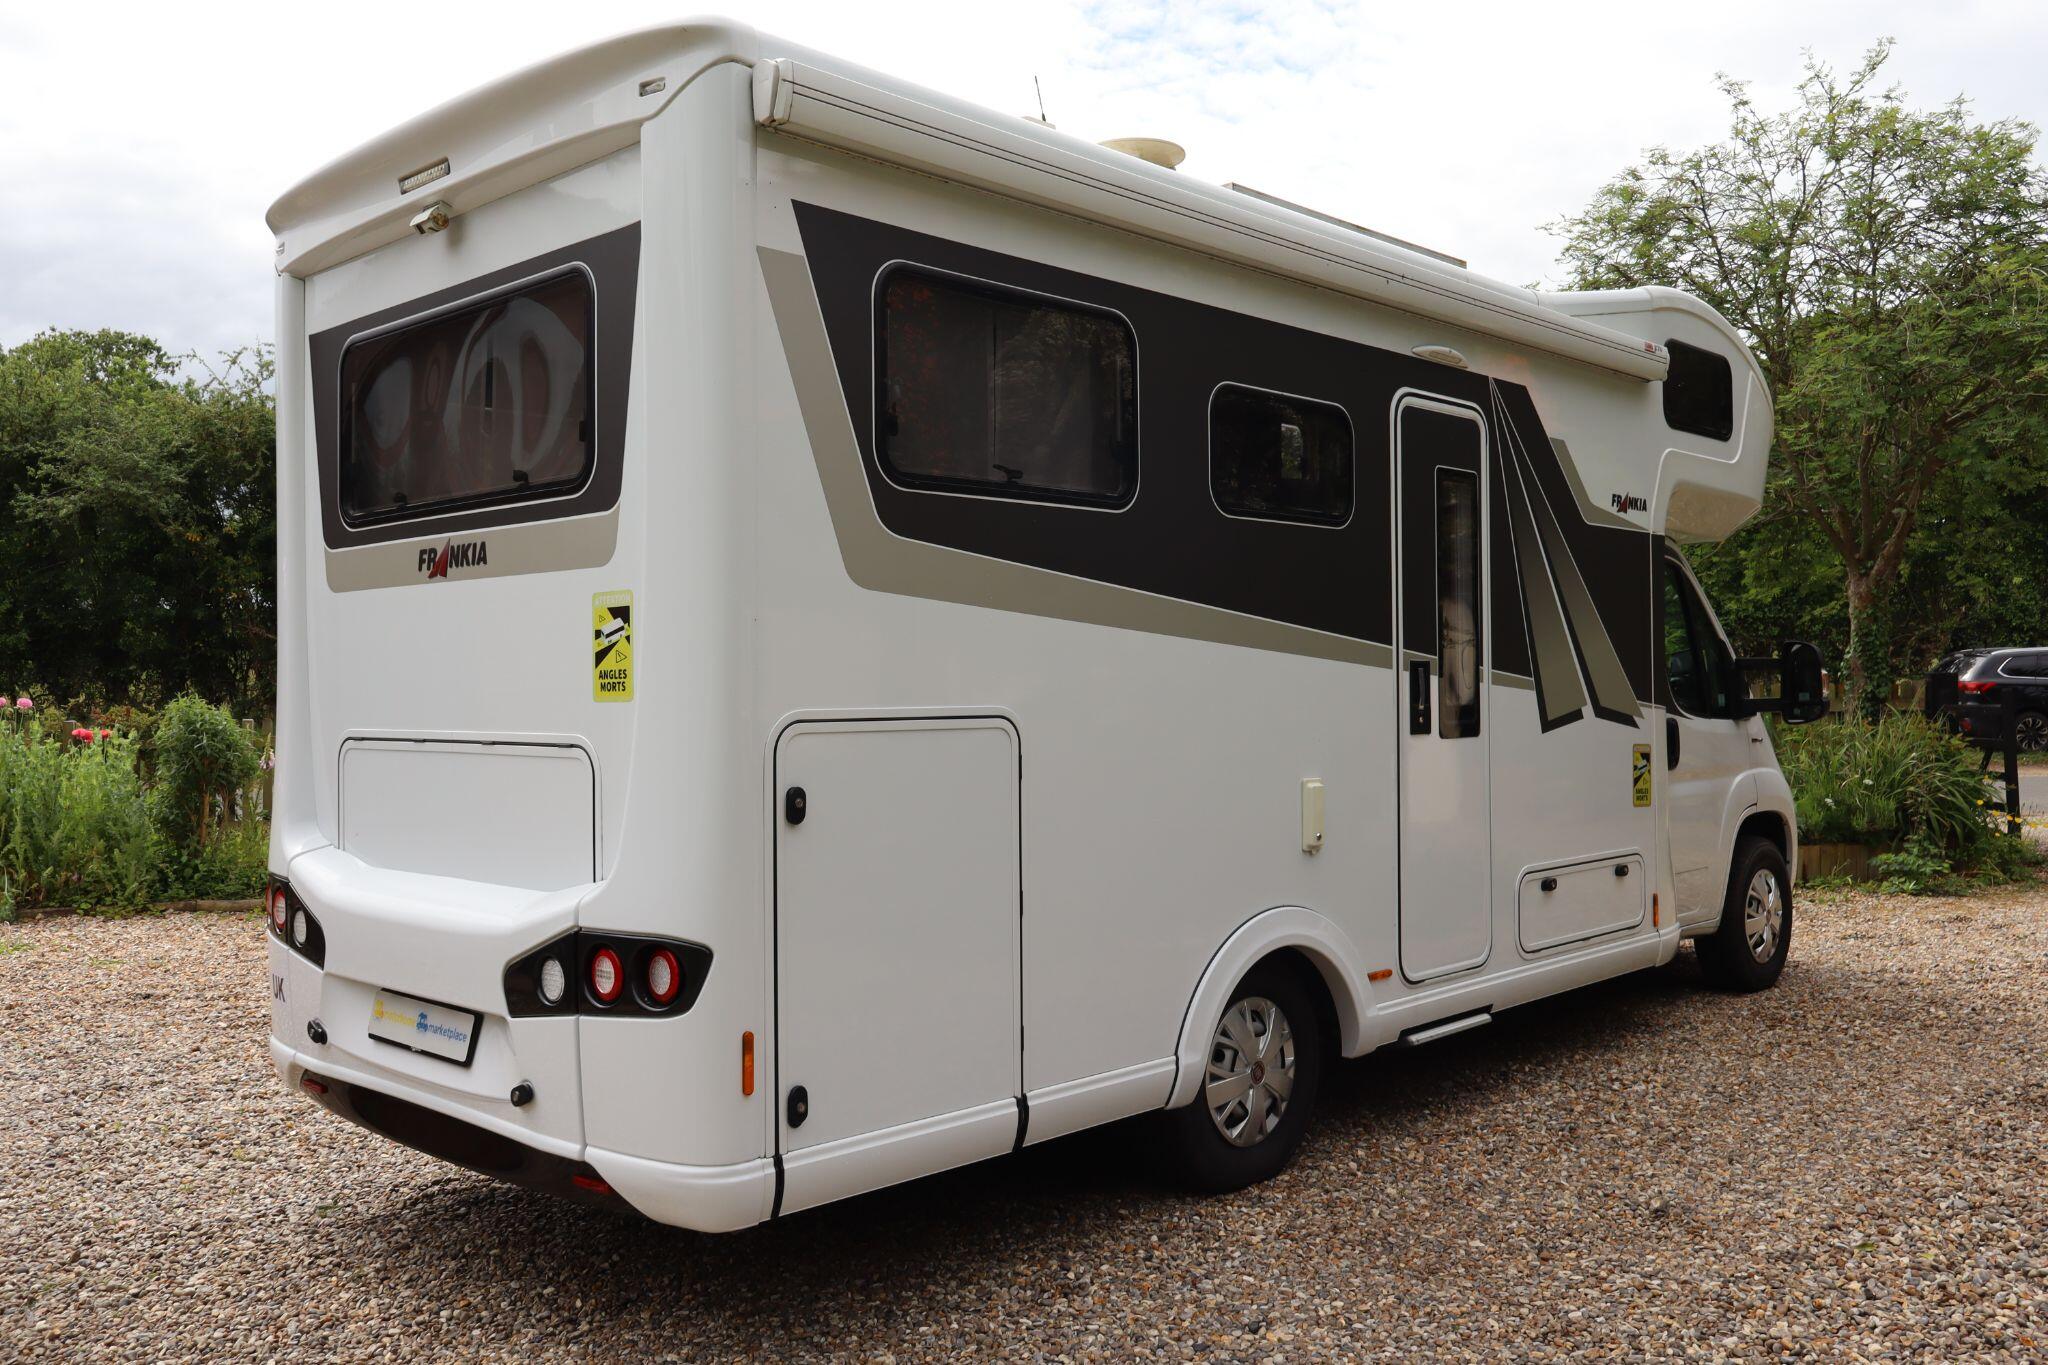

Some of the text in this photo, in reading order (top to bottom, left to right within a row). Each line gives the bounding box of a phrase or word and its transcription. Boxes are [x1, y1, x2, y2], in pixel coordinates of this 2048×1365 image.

[1611, 491, 1648, 514] FRANKIA
[418, 537, 488, 579] FRANKIA
[598, 669, 627, 680] ANGLES
[600, 681, 626, 692] MORTS
[272, 973, 285, 1002] UK
[428, 1023, 467, 1042] marketplace
